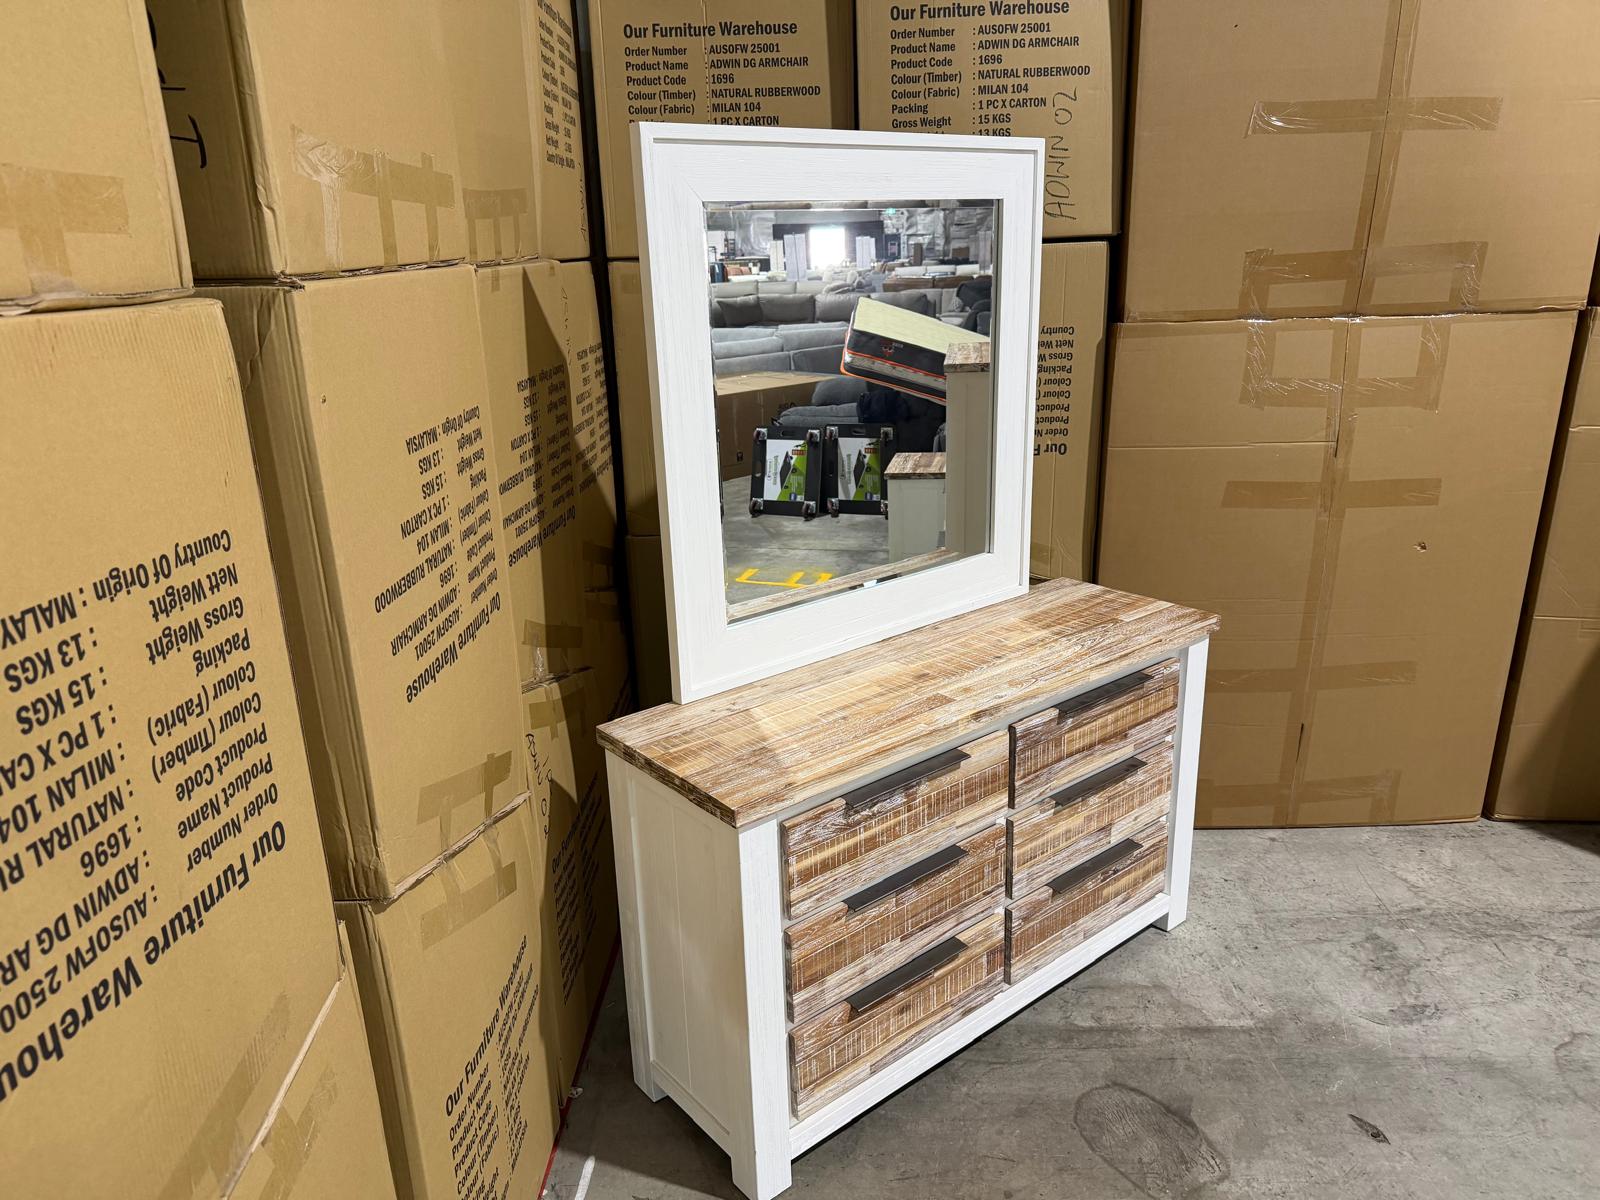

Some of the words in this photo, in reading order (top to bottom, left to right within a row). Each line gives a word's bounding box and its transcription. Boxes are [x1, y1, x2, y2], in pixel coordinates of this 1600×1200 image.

[890, 6, 916, 21] Our
[920, 2, 985, 19] Furniture
[989, 0, 1069, 15] Warehouse
[623, 24, 648, 38] Our
[652, 23, 715, 37] Furniture
[719, 21, 797, 36] Warehouse
[890, 29, 916, 39] Order
[918, 27, 955, 38] Number
[977, 23, 1018, 35] AUSOFW
[1020, 22, 1050, 33] 25001
[624, 47, 650, 56] Order
[652, 46, 687, 56] Number
[709, 44, 748, 54] AUSOFW
[750, 43, 780, 53] 25001
[891, 43, 927, 54] Product
[929, 42, 955, 52] Name
[978, 39, 1009, 50] ADWIN
[1012, 38, 1025, 48] DG
[1028, 36, 1079, 48] ARMCHAIR
[625, 61, 661, 71] Product
[662, 60, 688, 70] Name
[710, 58, 740, 69] ADWIN
[743, 58, 756, 68] DG
[758, 56, 808, 67] ARMCHAIR
[891, 58, 927, 69] Product
[929, 56, 952, 67] Code
[979, 54, 1002, 65] 1696
[891, 73, 921, 85] Colour
[923, 71, 961, 85] (Timber)
[978, 68, 1021, 79] NATURAL
[1023, 65, 1090, 77] RUBBERWOOD
[626, 75, 662, 86] Product
[663, 75, 686, 85] Code
[711, 73, 734, 84] 1696
[891, 89, 921, 99] Colour
[923, 86, 959, 100] (Fabric)
[978, 84, 1008, 95] MILAN
[1011, 83, 1029, 93] 104
[627, 91, 657, 100] Colour
[658, 89, 696, 102] (Timber)
[711, 88, 753, 98] NATURAL
[755, 86, 820, 97] RUBBERWOOD
[892, 103, 928, 114] Packing
[979, 100, 984, 110] 1
[986, 99, 999, 109] PC
[1001, 99, 1007, 109] X
[1009, 97, 1046, 108] CARTON
[1052, 86, 1077, 125] 02
[628, 105, 657, 115] Colour
[659, 104, 694, 116] (Fabric)
[712, 102, 741, 112] MILAN
[744, 102, 761, 112] 104
[721, 117, 733, 125] PC
[735, 117, 741, 125] X
[743, 115, 779, 126] CARTON
[892, 119, 917, 129] Gross
[920, 116, 951, 128] Weight
[978, 114, 990, 124] 15
[992, 113, 1011, 123] KGS
[978, 128, 990, 136] 13
[992, 127, 1011, 137] KGS
[1044, 136, 1077, 220] ADWIN
[1041, 326, 1074, 336] Country
[1055, 339, 1074, 348] Nett
[1038, 365, 1072, 374] Packing
[1048, 352, 1073, 361] Gross
[1042, 390, 1071, 399] Colour
[1043, 377, 1071, 386] Colour
[463, 405, 480, 424] Country
[1036, 416, 1069, 424] Product
[1037, 403, 1070, 412] Product
[441, 416, 457, 436] Origin
[1044, 428, 1068, 437] Order
[405, 427, 438, 455] MALAYSIA
[1043, 443, 1067, 455] Our
[418, 454, 432, 475] KGS
[432, 450, 440, 467] 13
[421, 478, 435, 500] KGS
[435, 473, 443, 492] 15
[432, 500, 442, 518] PC
[441, 497, 446, 512] 1
[458, 496, 475, 524] (Fabric)
[476, 488, 489, 507] Colour
[400, 509, 427, 539] CARTON
[427, 505, 433, 521] X
[478, 508, 491, 528] Colour
[542, 512, 566, 539] Furniture
[566, 505, 575, 521] Our
[416, 533, 429, 555] 104
[429, 519, 450, 545] MILAN
[459, 517, 478, 546] (Timber)
[477, 528, 493, 553] Product
[175, 529, 231, 568] Country
[424, 541, 452, 573] NATURAL
[467, 543, 478, 562] Code
[479, 547, 495, 574] Product
[508, 533, 542, 567] Warehouse
[152, 554, 171, 584] Of
[206, 563, 238, 595] Nett
[439, 564, 454, 588] 1696
[468, 564, 480, 583] Name
[486, 568, 497, 586] Order
[93, 564, 149, 602] Origin
[375, 562, 425, 613] RUBBERWOOD
[471, 579, 487, 604] Number
[149, 578, 207, 622] Weight
[204, 596, 243, 629] Gross
[428, 603, 438, 622] DG
[438, 585, 457, 614] ADWIN
[490, 592, 500, 614] Our
[1, 592, 76, 649] MALAY
[390, 611, 427, 656] ARMCHAIR
[436, 606, 459, 642] AUSOFW
[458, 605, 490, 650] Furniture
[57, 633, 85, 667] 13
[146, 618, 204, 665] Weight
[193, 628, 250, 677] Packing
[414, 629, 436, 661] 25001
[4, 648, 54, 692] KGS
[213, 661, 255, 700] Colour
[406, 641, 458, 703] Warehouse
[68, 673, 95, 707] 15
[16, 688, 65, 735] KGS
[90, 711, 105, 738] 1
[148, 685, 209, 746] (Fabric)
[219, 692, 261, 734] Colour
[58, 721, 88, 758] PC
[152, 718, 216, 783] (Timber)
[214, 722, 267, 776] Product
[37, 739, 56, 770] X
[46, 749, 115, 812] MILAN
[176, 763, 214, 801] Code
[221, 752, 273, 808] Product
[178, 793, 221, 838] Name
[244, 783, 278, 823] Order
[0, 794, 41, 843] 104
[26, 786, 124, 867] NATURAL
[80, 824, 131, 877] 1696
[187, 813, 242, 872] Number
[252, 821, 285, 867] Our
[73, 857, 138, 928] ADWIN
[144, 853, 249, 964] Furniture
[36, 913, 71, 955] DG
[66, 892, 146, 981] AUSOFW
[0, 965, 61, 1033] 2500
[446, 1078, 463, 1116] Our
[465, 1008, 499, 1084] Furniture
[499, 935, 526, 1011] Warehouse
